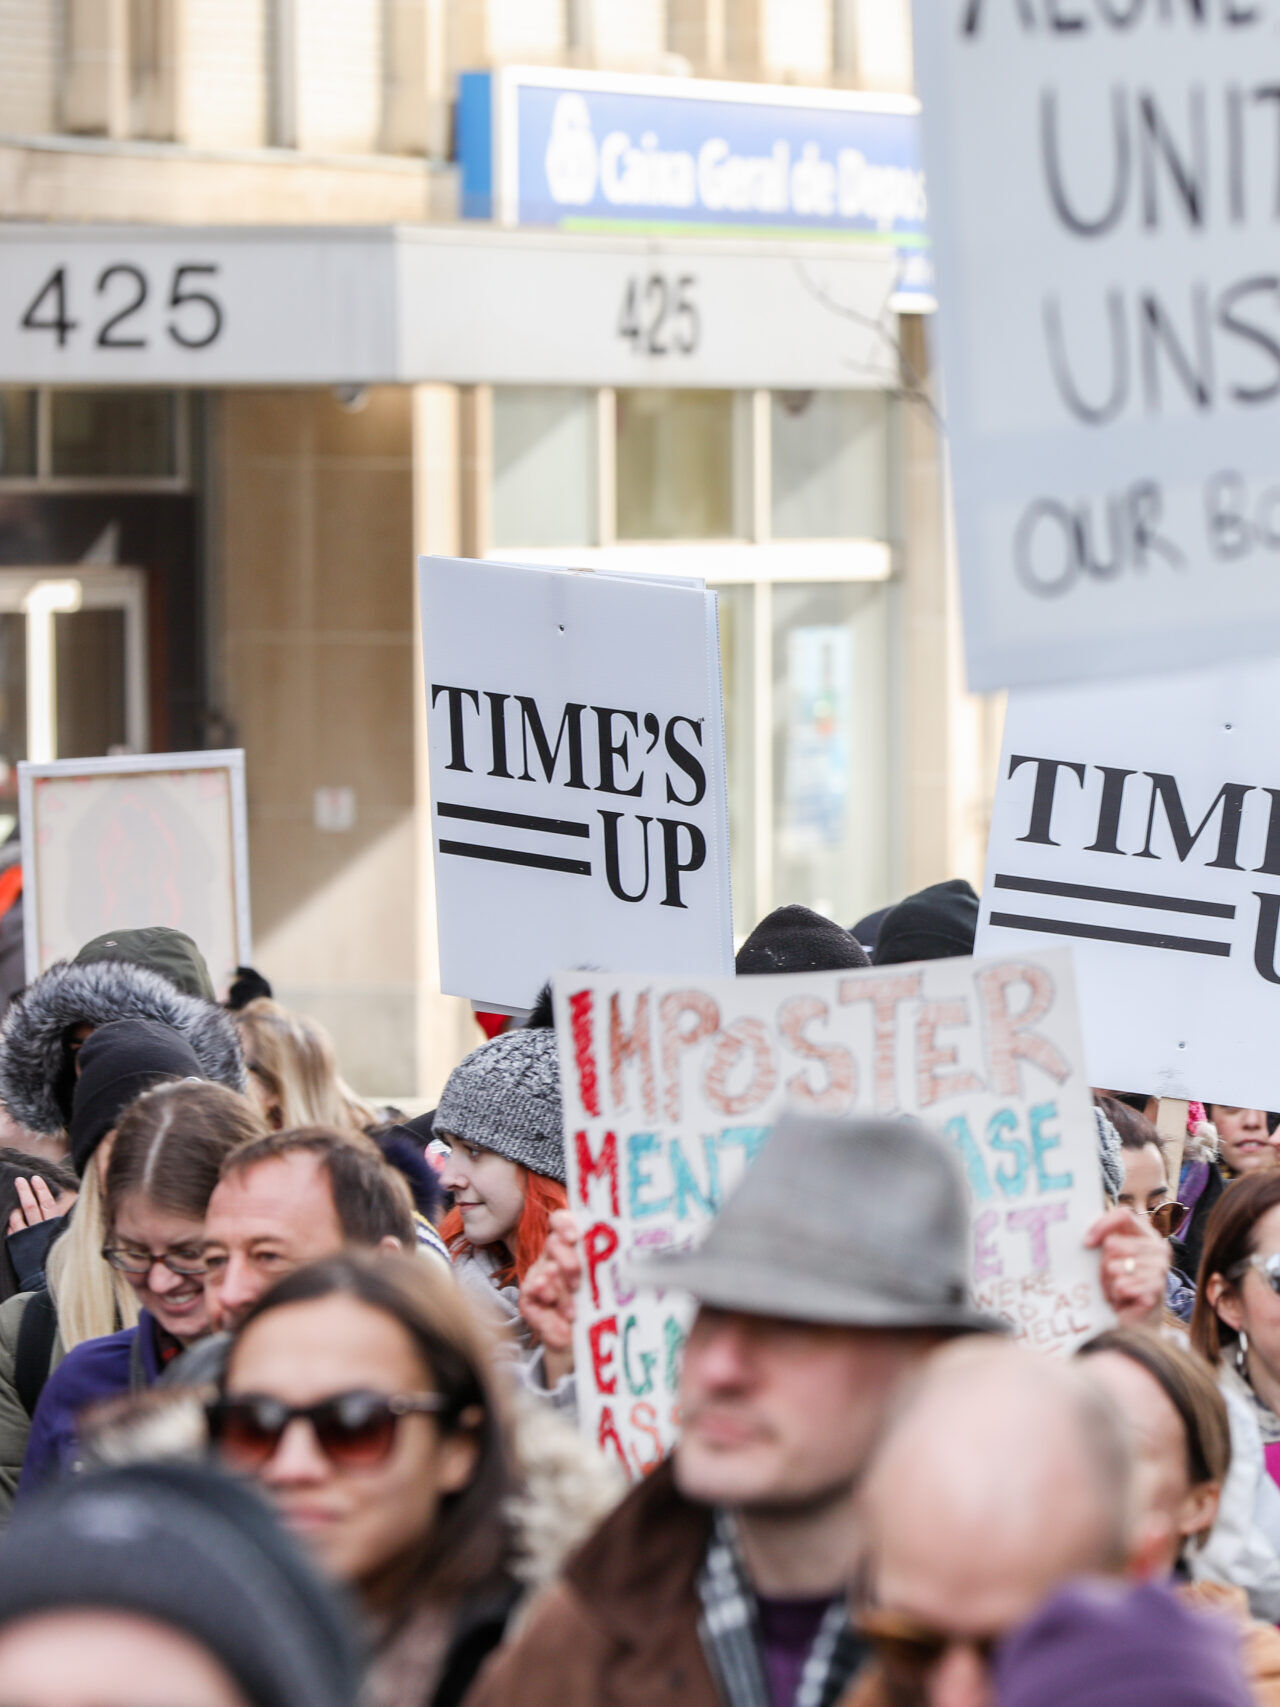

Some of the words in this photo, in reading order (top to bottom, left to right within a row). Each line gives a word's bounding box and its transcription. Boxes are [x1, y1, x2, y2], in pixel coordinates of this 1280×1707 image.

[20, 264, 225, 350] 425
[617, 274, 701, 359] 425
[1011, 476, 1188, 602] OUR
[431, 683, 707, 807] TIME'S
[596, 808, 708, 910] UP
[568, 961, 1074, 1123] IMPOSTER
